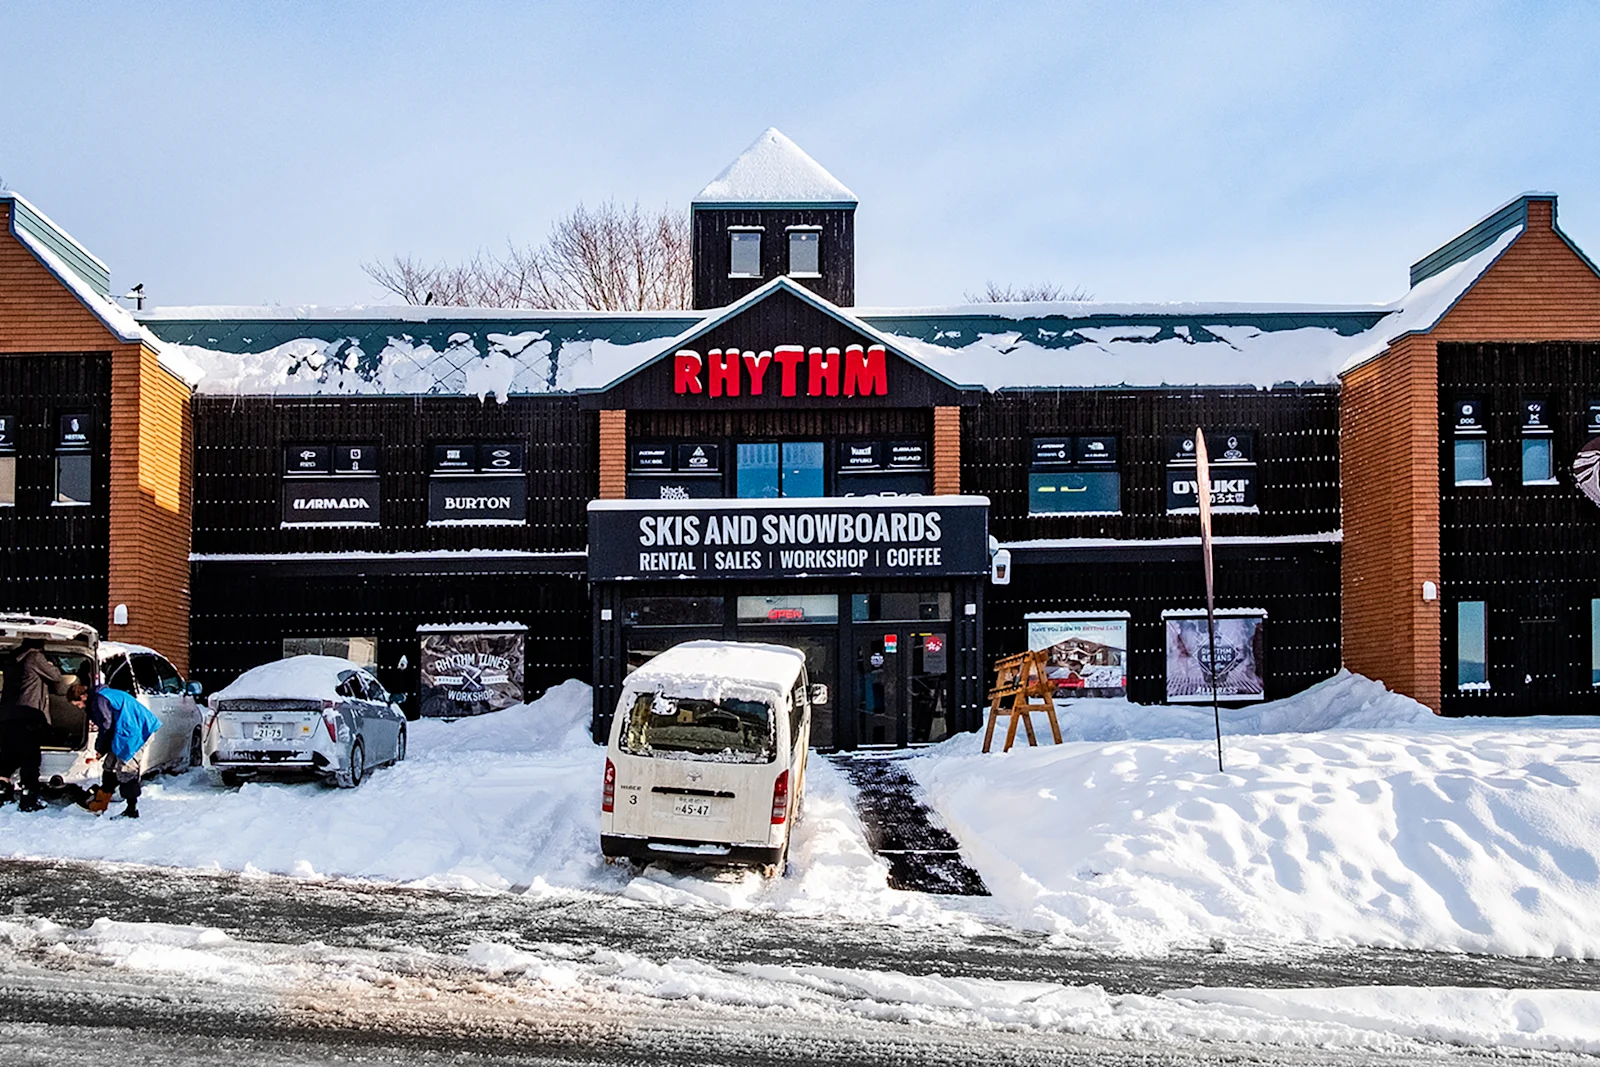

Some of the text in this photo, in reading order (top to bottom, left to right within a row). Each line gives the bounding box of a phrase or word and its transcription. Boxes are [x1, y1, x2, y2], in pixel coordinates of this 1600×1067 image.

[674, 345, 888, 397] RHYTHM
[660, 485, 685, 494] black
[304, 498, 370, 509] ARMADA
[445, 497, 511, 509] BURTON
[639, 511, 942, 547] SKIS AND SNOWBOARDS
[639, 547, 942, 571] RENTAL SALES WORKSHOP COFFEE
[768, 609, 803, 619] OPEN
[434, 653, 511, 672] RHYTHM TUNES
[448, 689, 495, 702] WORKSHOP
[629, 794, 638, 805] 3
[681, 804, 709, 816] 45-47
